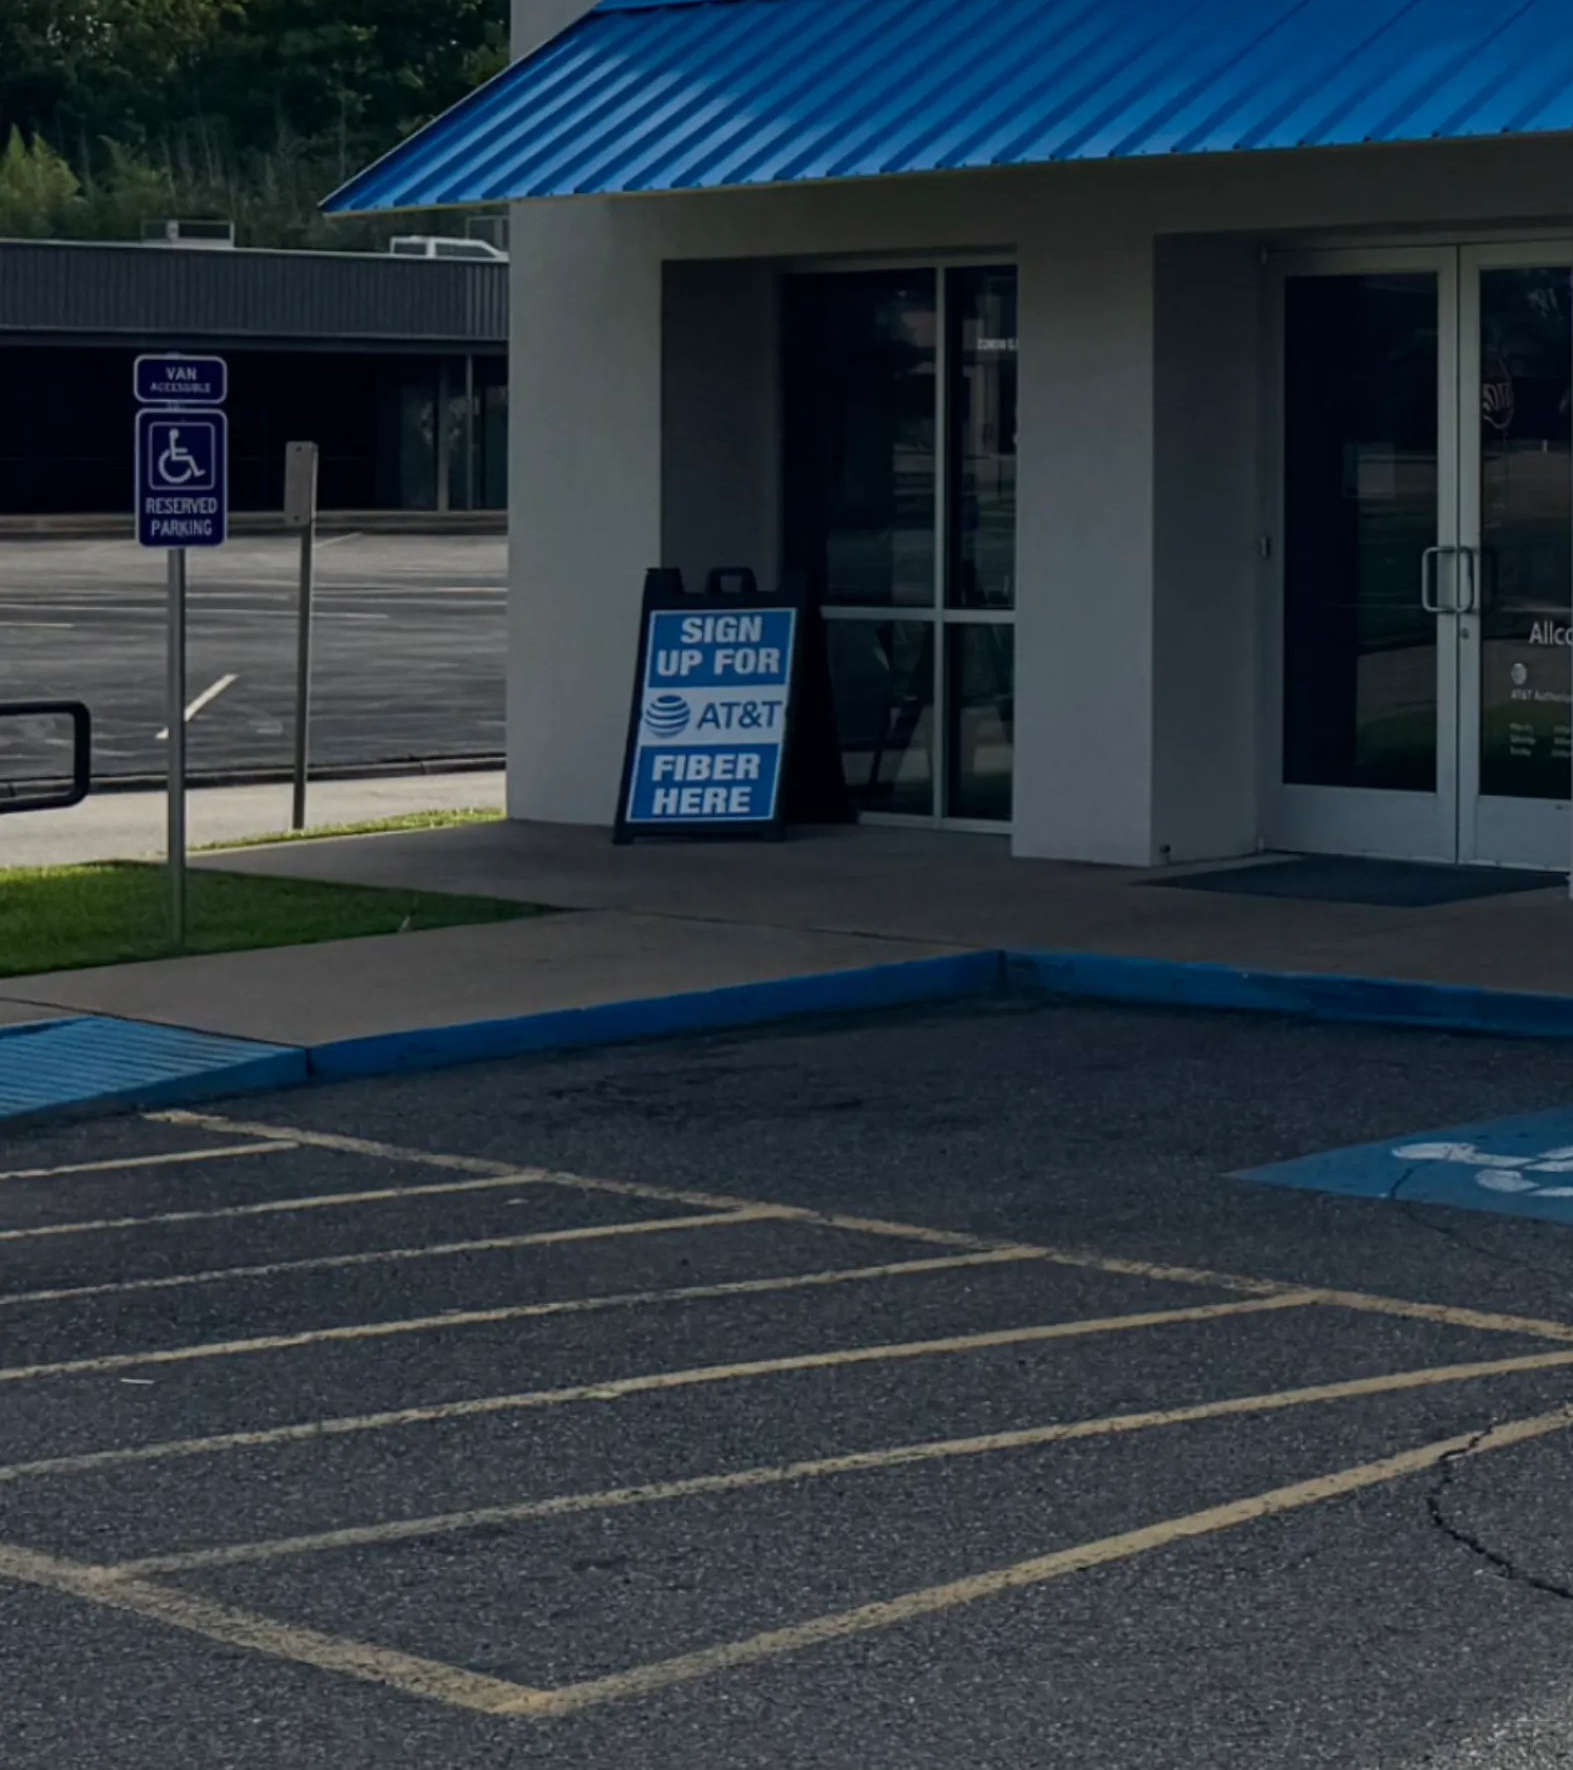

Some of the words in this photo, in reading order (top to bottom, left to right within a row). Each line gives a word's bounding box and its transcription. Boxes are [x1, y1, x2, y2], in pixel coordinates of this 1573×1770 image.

[165, 365, 197, 381] VAN
[150, 382, 211, 394] ACCESSIBLE
[145, 496, 218, 514] RESERVED
[151, 519, 213, 537] PARKING
[680, 615, 763, 644] SIGN
[656, 649, 703, 677] UP
[714, 647, 780, 676] FOR
[697, 700, 783, 730] AT&T
[651, 752, 761, 782] FIBER
[652, 786, 753, 816] HERE
